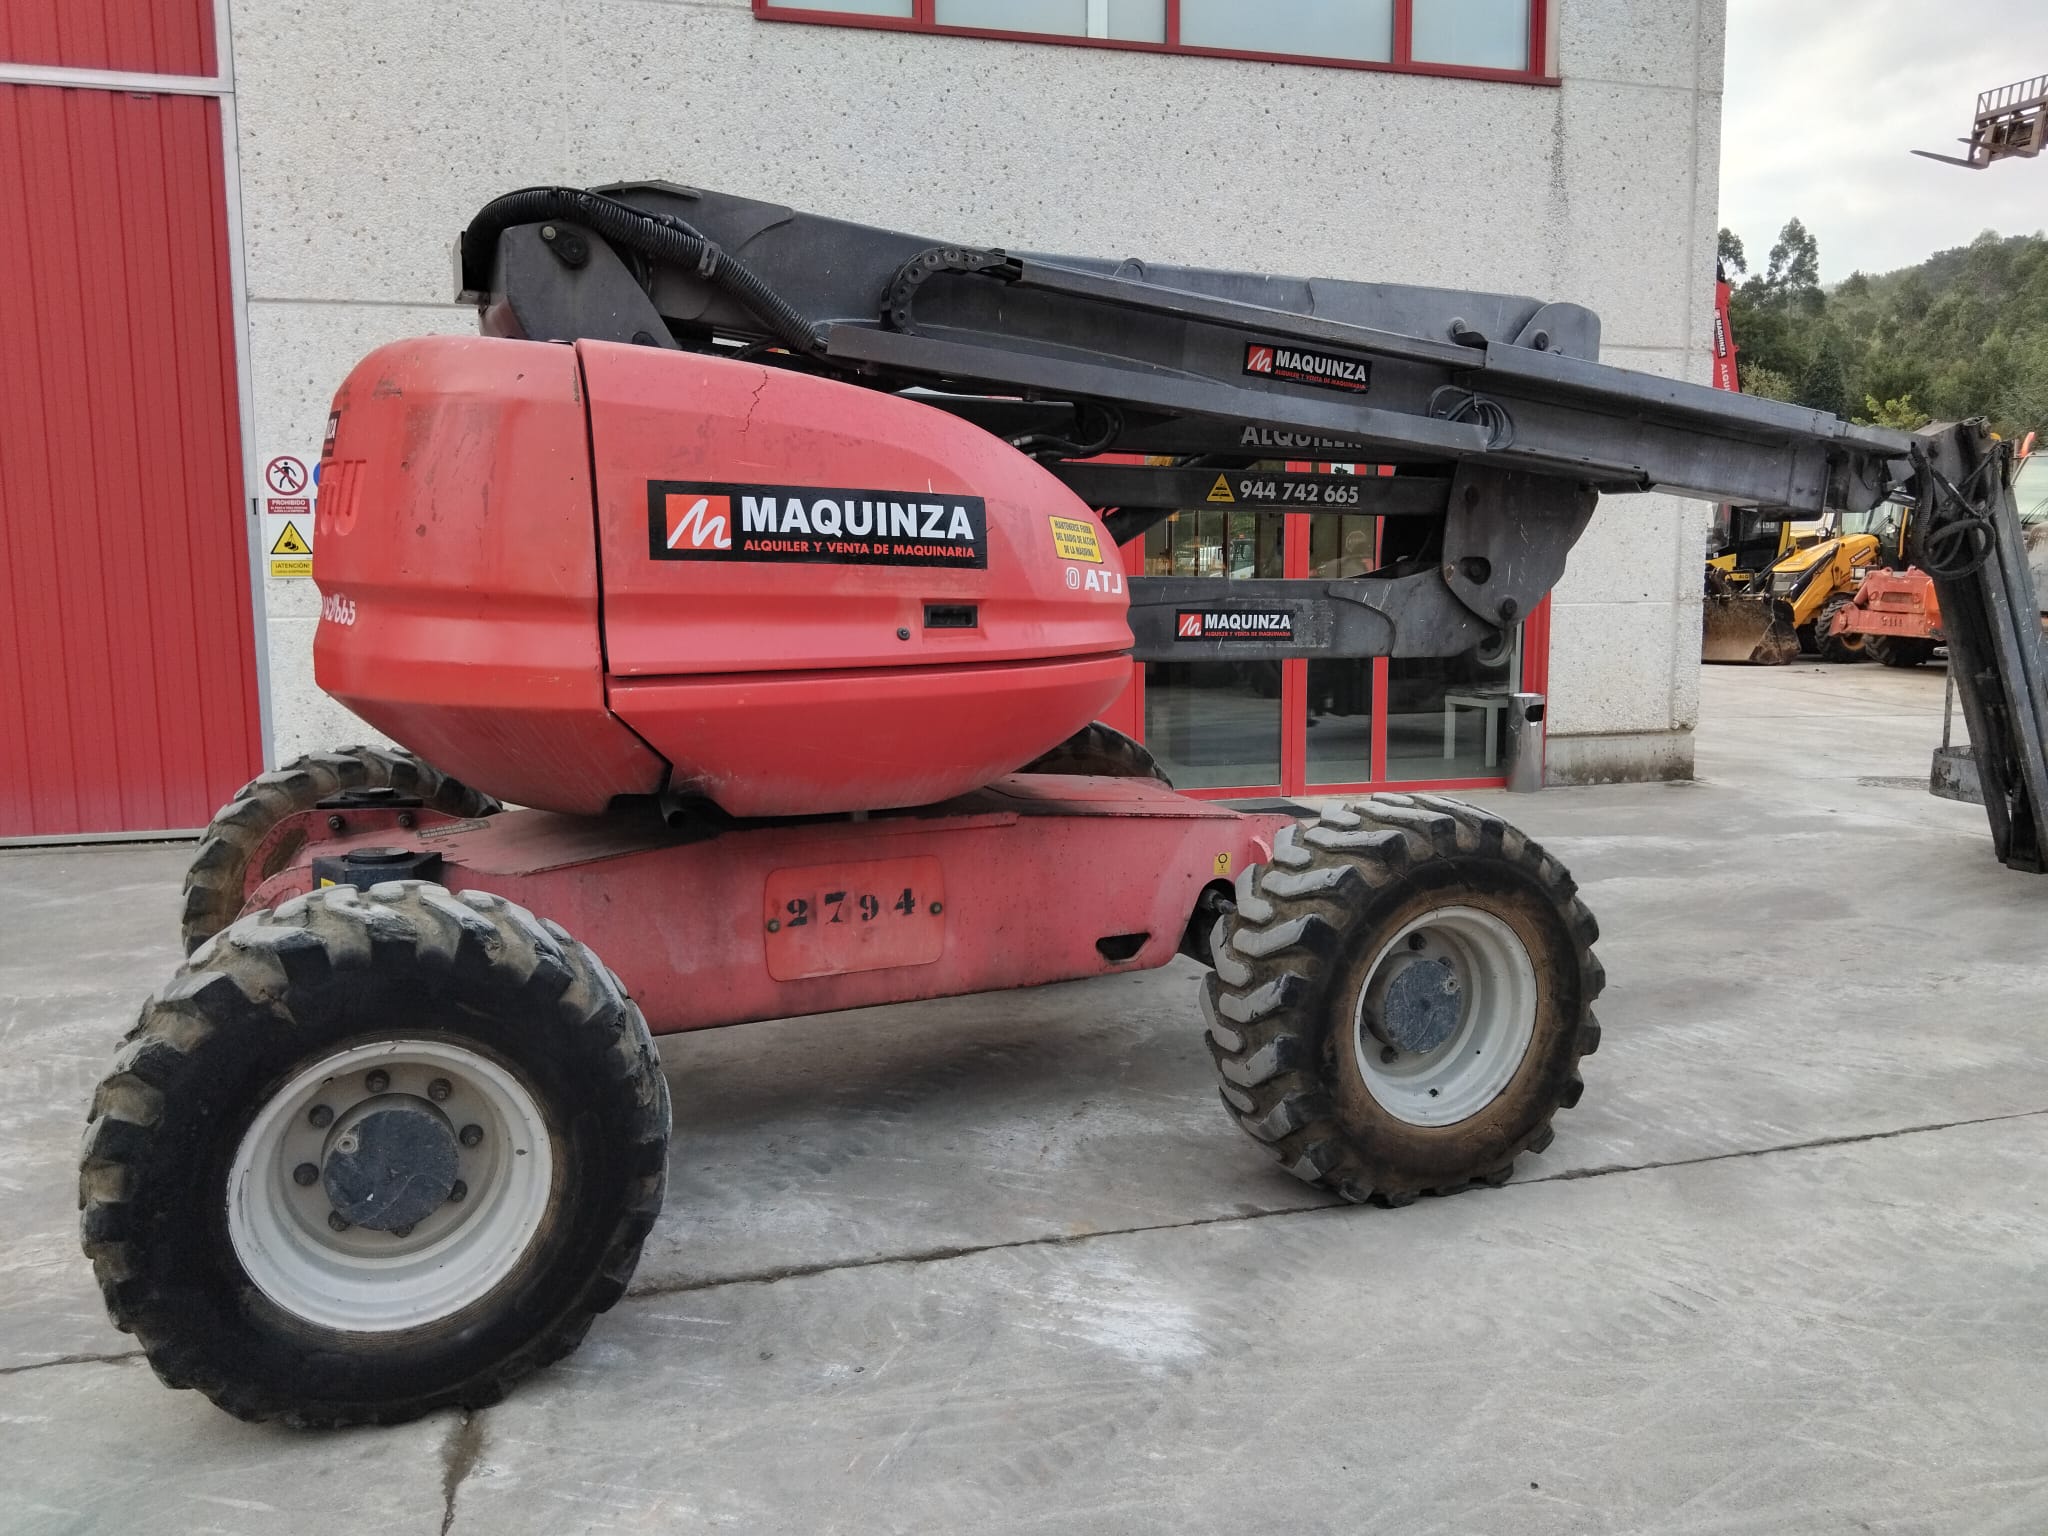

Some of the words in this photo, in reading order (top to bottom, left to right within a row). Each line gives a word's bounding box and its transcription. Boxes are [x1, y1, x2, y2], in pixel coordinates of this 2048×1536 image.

[1276, 350, 1366, 381] MAQUINZA
[1721, 363, 1731, 391] ALQU
[1241, 426, 1362, 448] ALQU
[1240, 480, 1276, 499] 944
[1282, 483, 1318, 502] 742
[1324, 486, 1358, 503] 665
[742, 496, 975, 540] MAQUINZA
[743, 539, 809, 553] ALQUILER
[812, 541, 822, 553] Y
[826, 542, 869, 555] VENTA
[873, 544, 889, 556] DE
[893, 545, 975, 559] MAQUINARIA
[1084, 569, 1122, 593] ATJ
[1204, 614, 1291, 630] MAQUINZA
[786, 888, 916, 928] 2794
